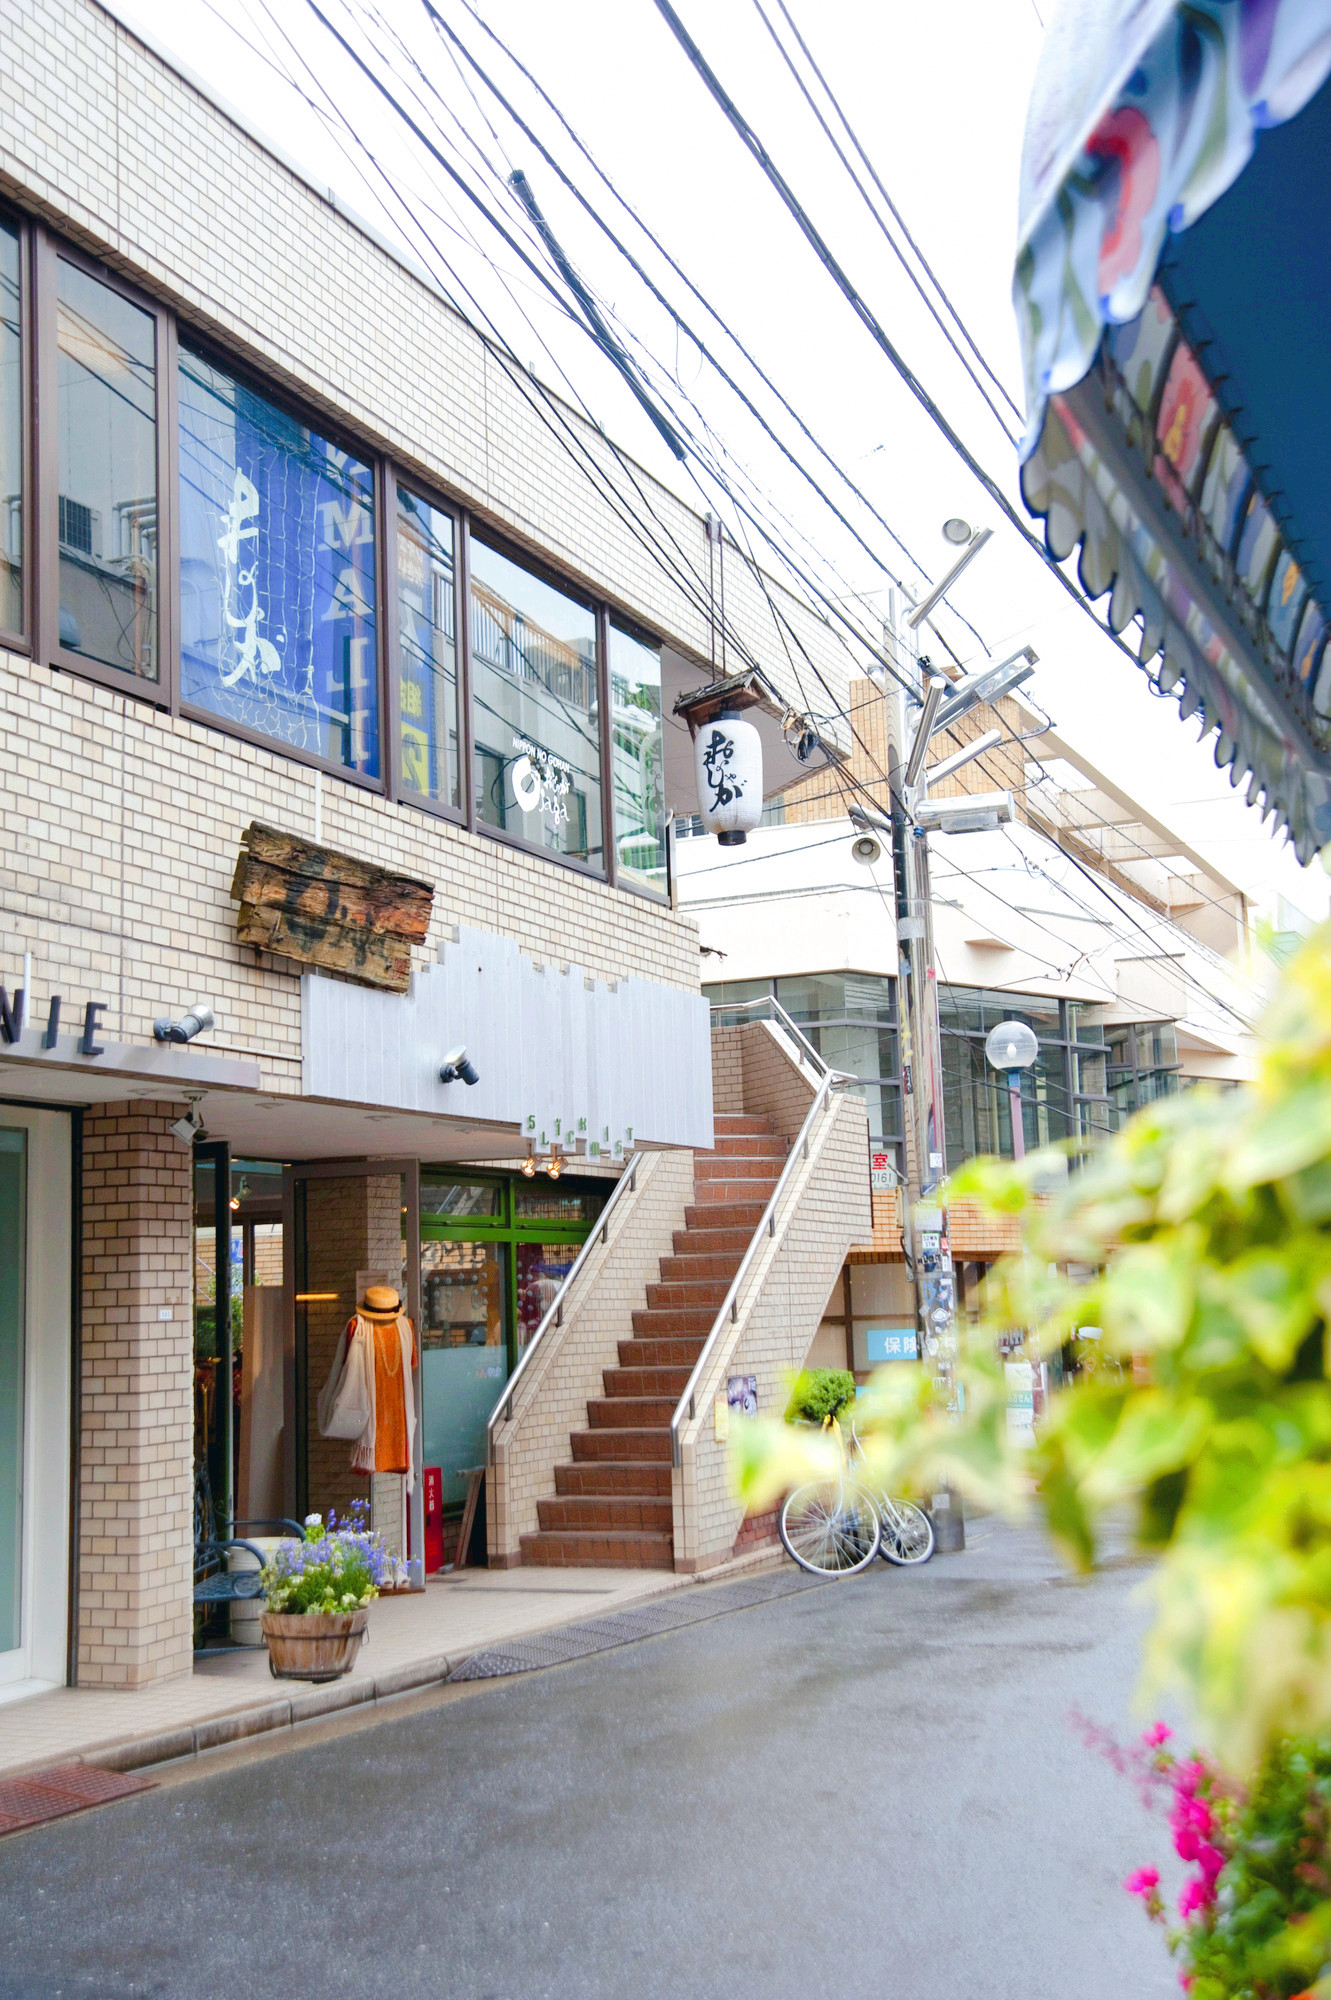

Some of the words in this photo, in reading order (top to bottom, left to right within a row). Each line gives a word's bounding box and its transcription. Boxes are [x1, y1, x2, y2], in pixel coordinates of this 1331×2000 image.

[512, 737, 536, 757] NIPPON
[537, 748, 547, 763] NO
[548, 754, 570, 773] GOHAN
[872, 1153, 888, 1170] 室
